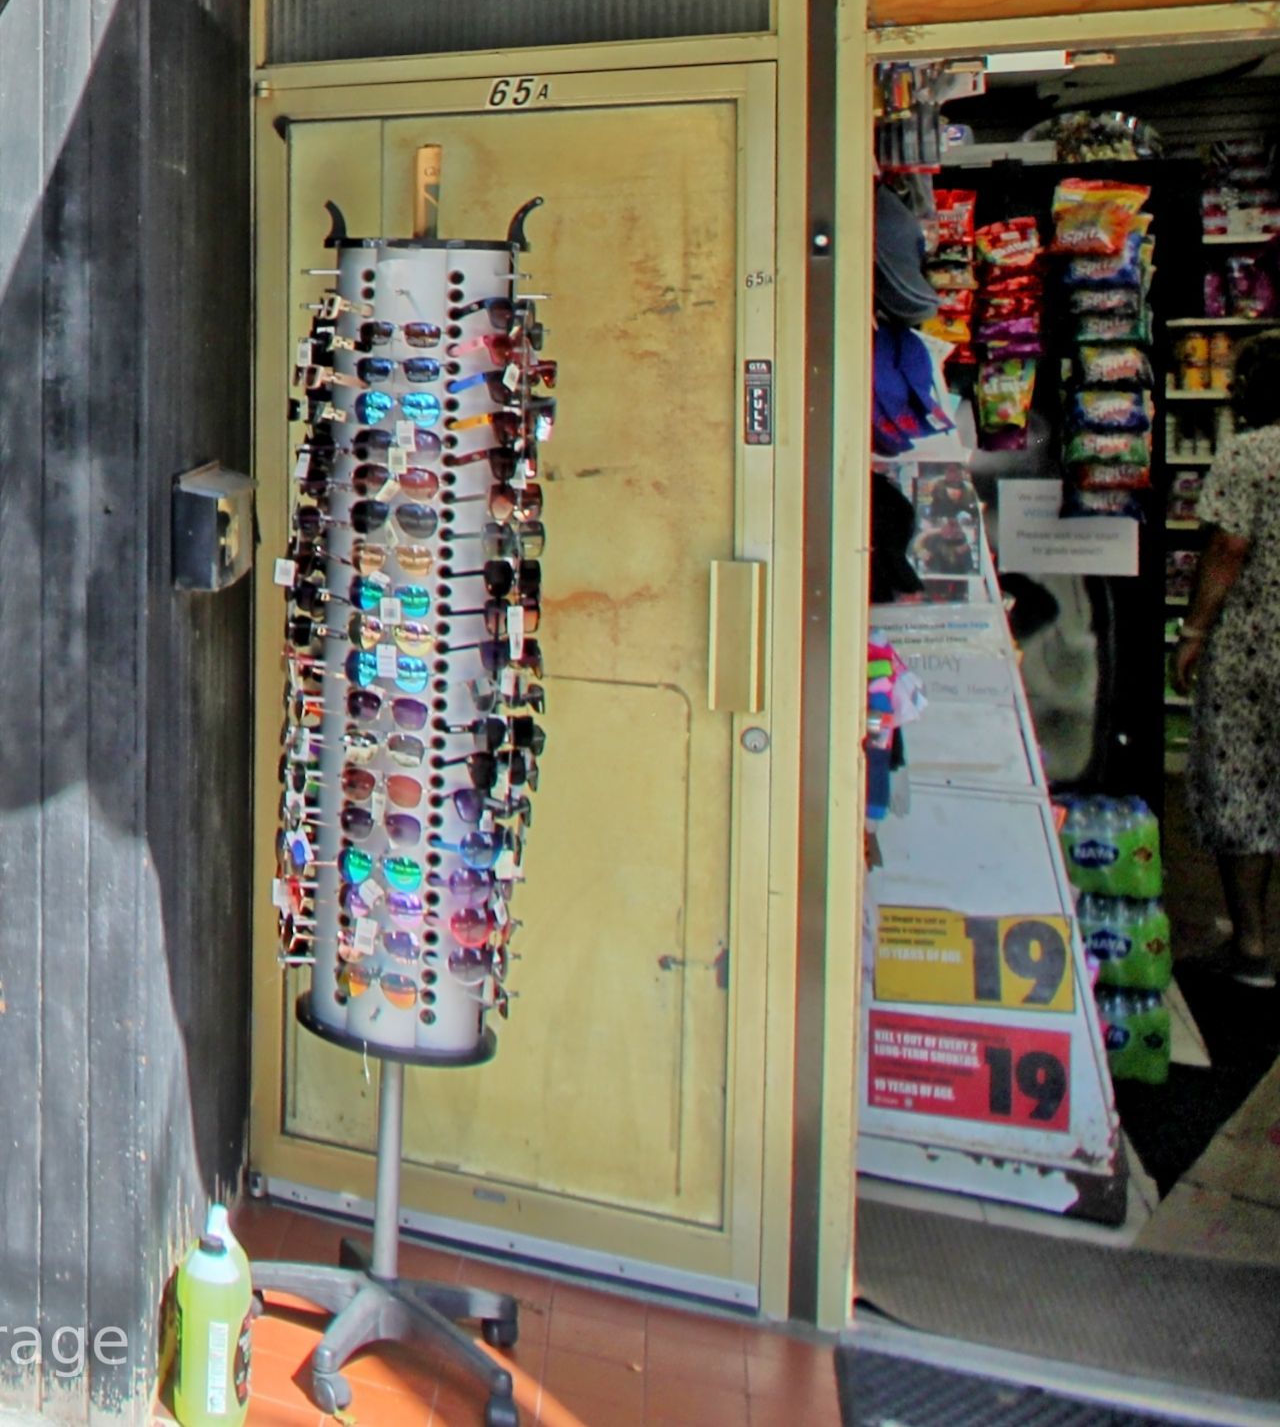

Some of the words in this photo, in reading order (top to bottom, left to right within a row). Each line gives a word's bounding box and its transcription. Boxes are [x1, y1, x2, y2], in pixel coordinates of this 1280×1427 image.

[748, 362, 768, 372] GTA
[753, 388, 763, 432] PULL
[964, 915, 1067, 1005] 19
[984, 1045, 1067, 1122] 19
